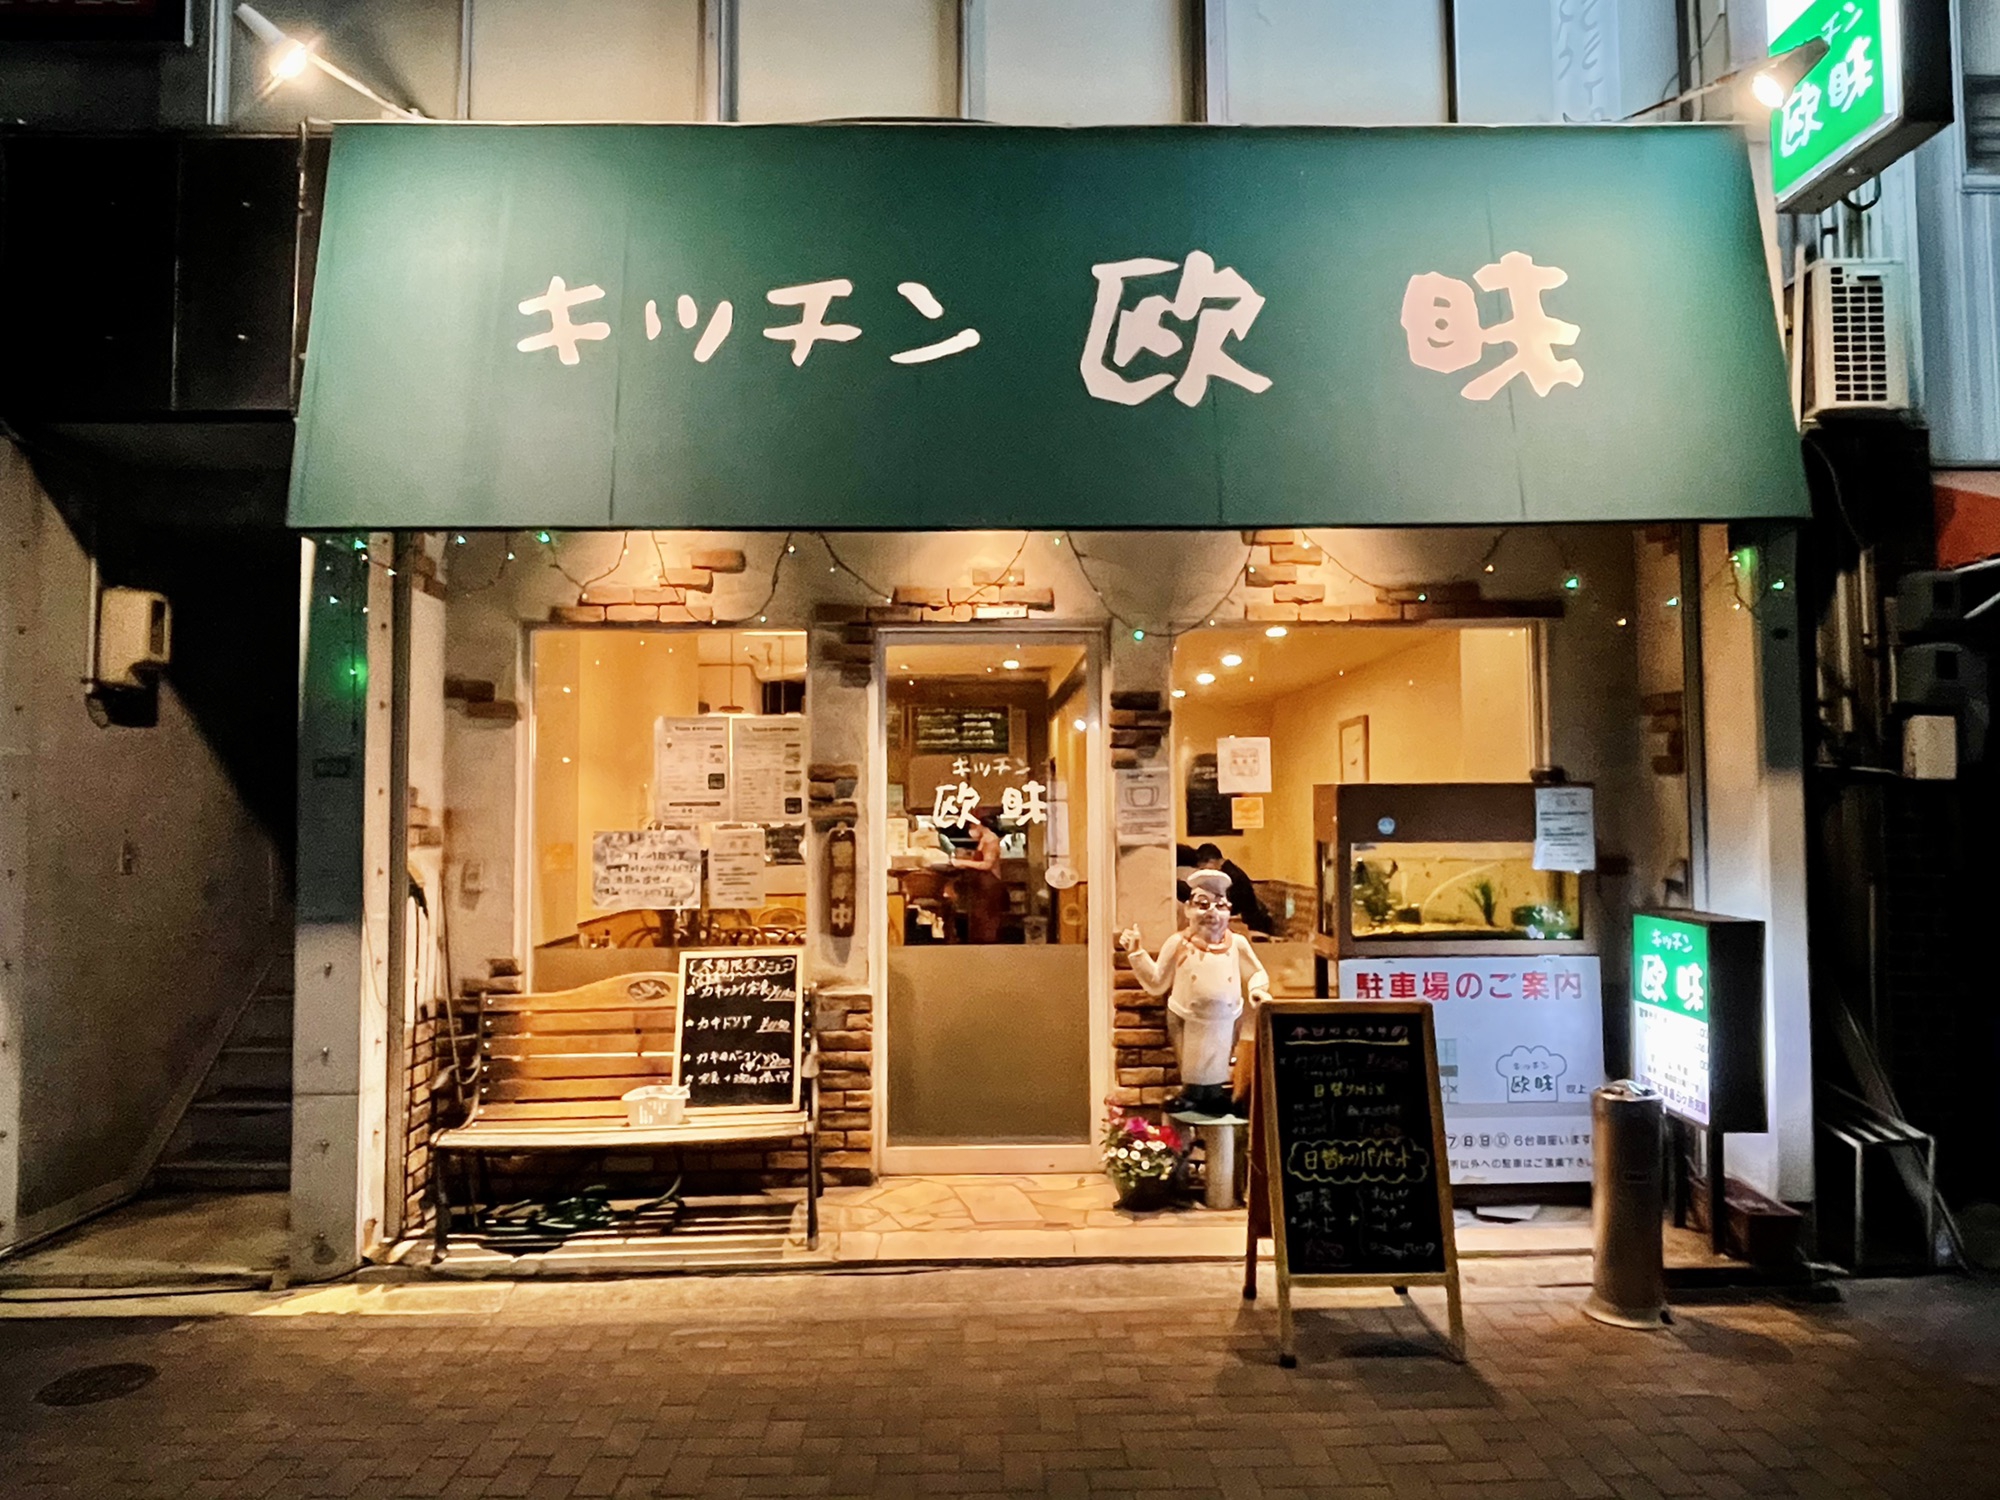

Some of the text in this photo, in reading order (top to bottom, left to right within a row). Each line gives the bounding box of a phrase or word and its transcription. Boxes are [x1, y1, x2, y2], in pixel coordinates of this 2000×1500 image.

[516, 276, 981, 366] キッチン
[952, 757, 1031, 777] キッチン
[1651, 928, 1693, 953] キッチン
[1356, 971, 1583, 1000] 駐車場のご案内
